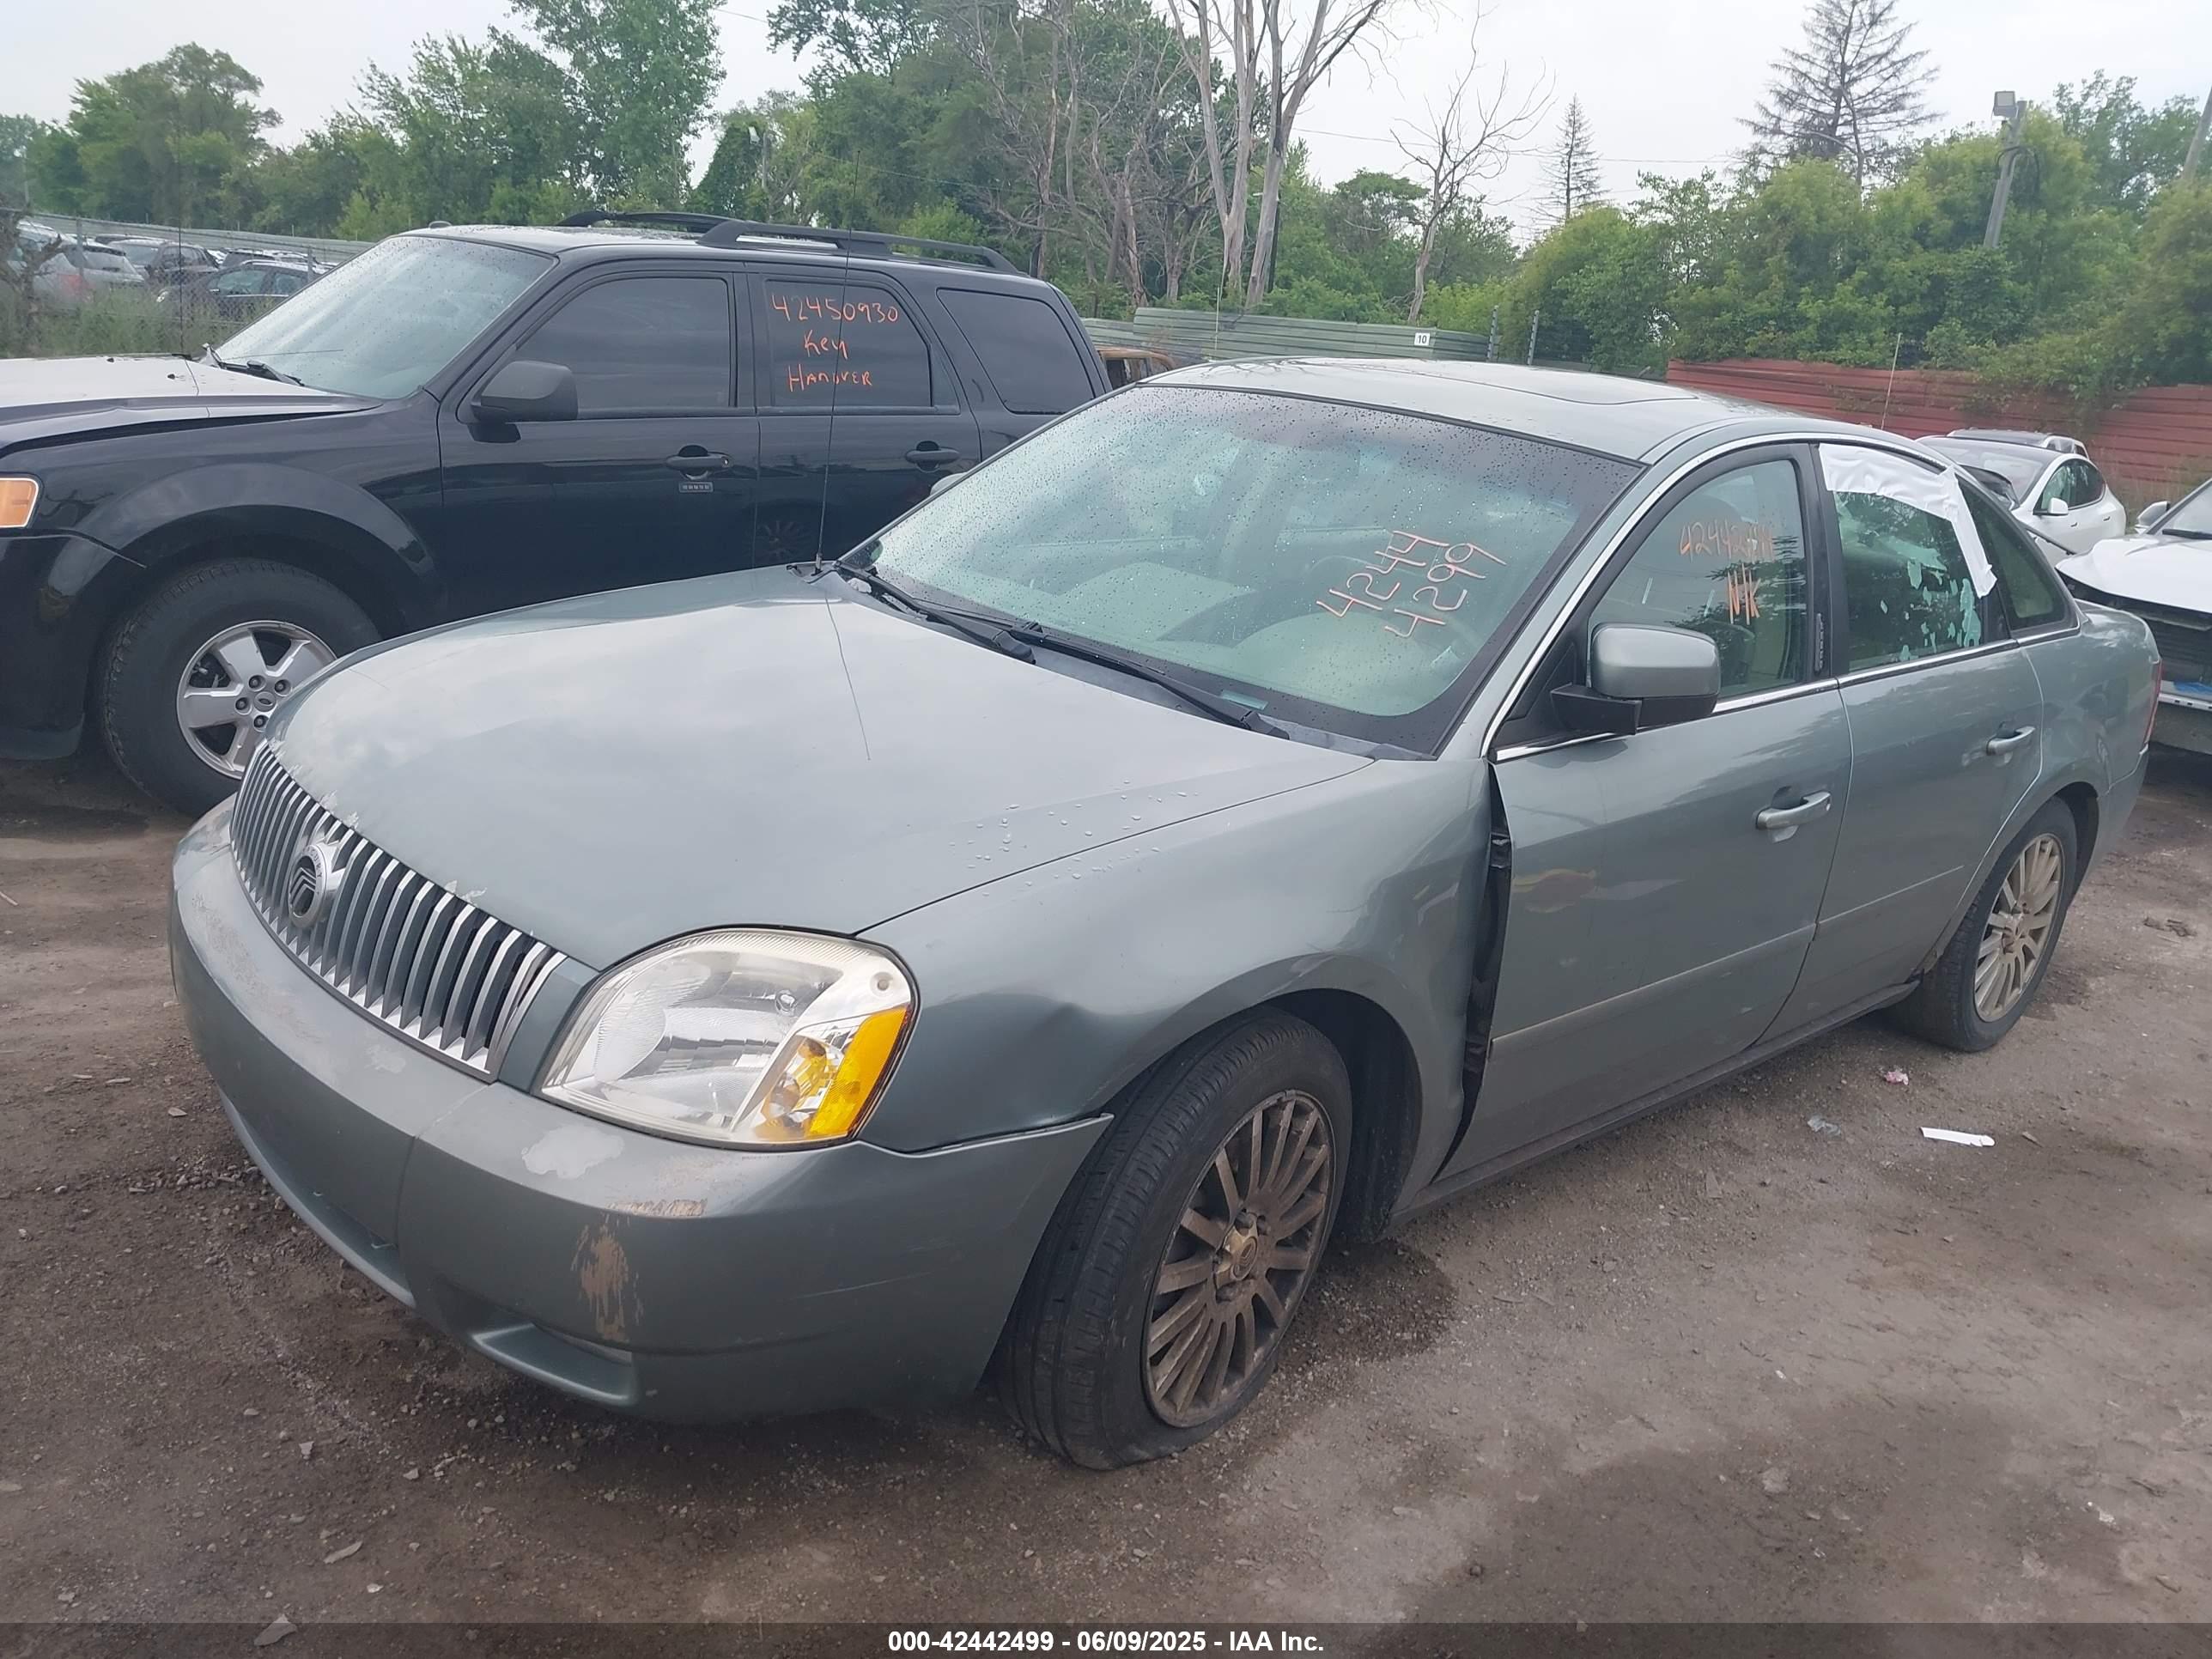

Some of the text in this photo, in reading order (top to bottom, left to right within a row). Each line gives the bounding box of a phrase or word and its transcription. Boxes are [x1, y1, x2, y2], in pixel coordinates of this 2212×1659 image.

[772, 295, 899, 324] 42450930
[803, 329, 848, 360] Key
[1417, 335, 1427, 344] 10
[1316, 530, 1450, 617] 4244
[1383, 542, 1508, 638] 4299
